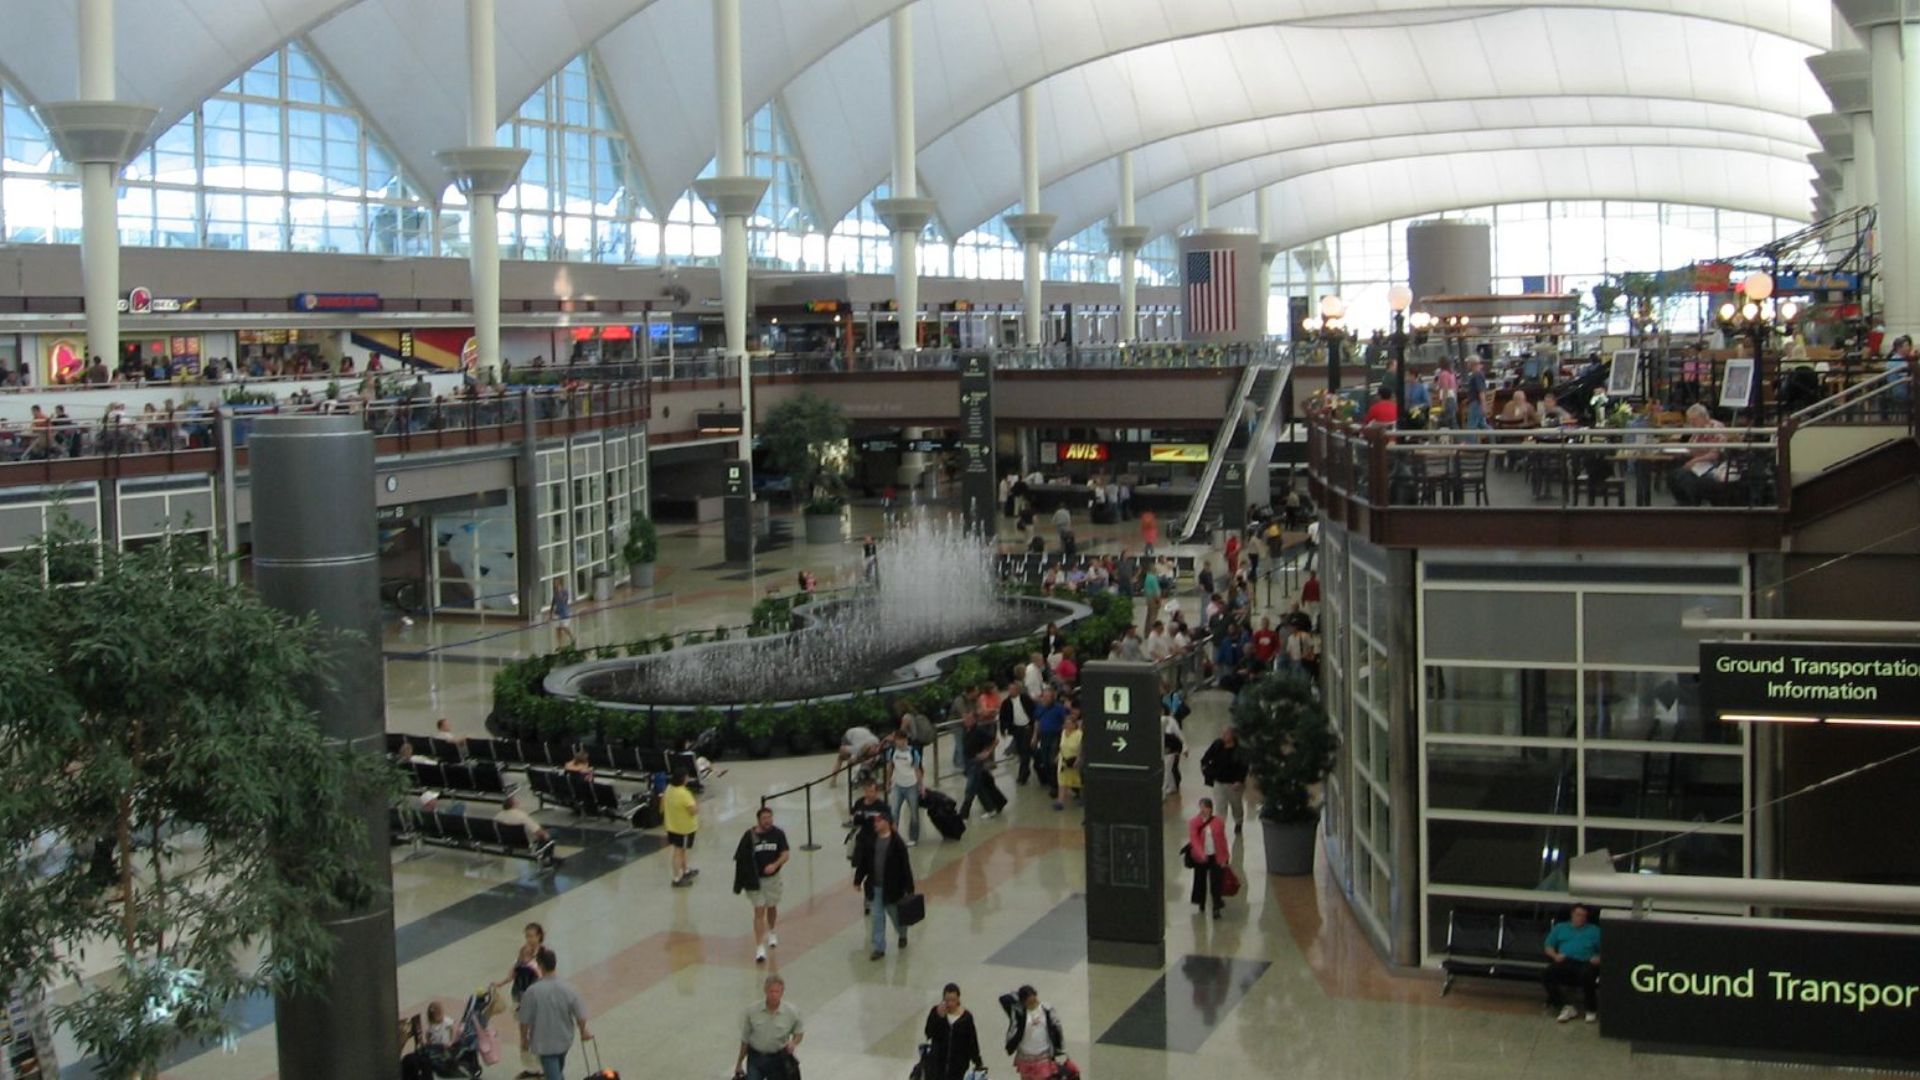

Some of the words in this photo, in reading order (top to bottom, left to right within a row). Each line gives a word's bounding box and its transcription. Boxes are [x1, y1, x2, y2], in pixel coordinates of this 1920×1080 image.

[1066, 444, 1098, 459] AVIS
[1716, 656, 1784, 673] Ground
[1791, 657, 1920, 678] Transportatio
[1768, 681, 1877, 700] Information
[1106, 720, 1129, 731] Men
[1630, 964, 1754, 998] Ground
[1768, 971, 1920, 1012] Transpor
